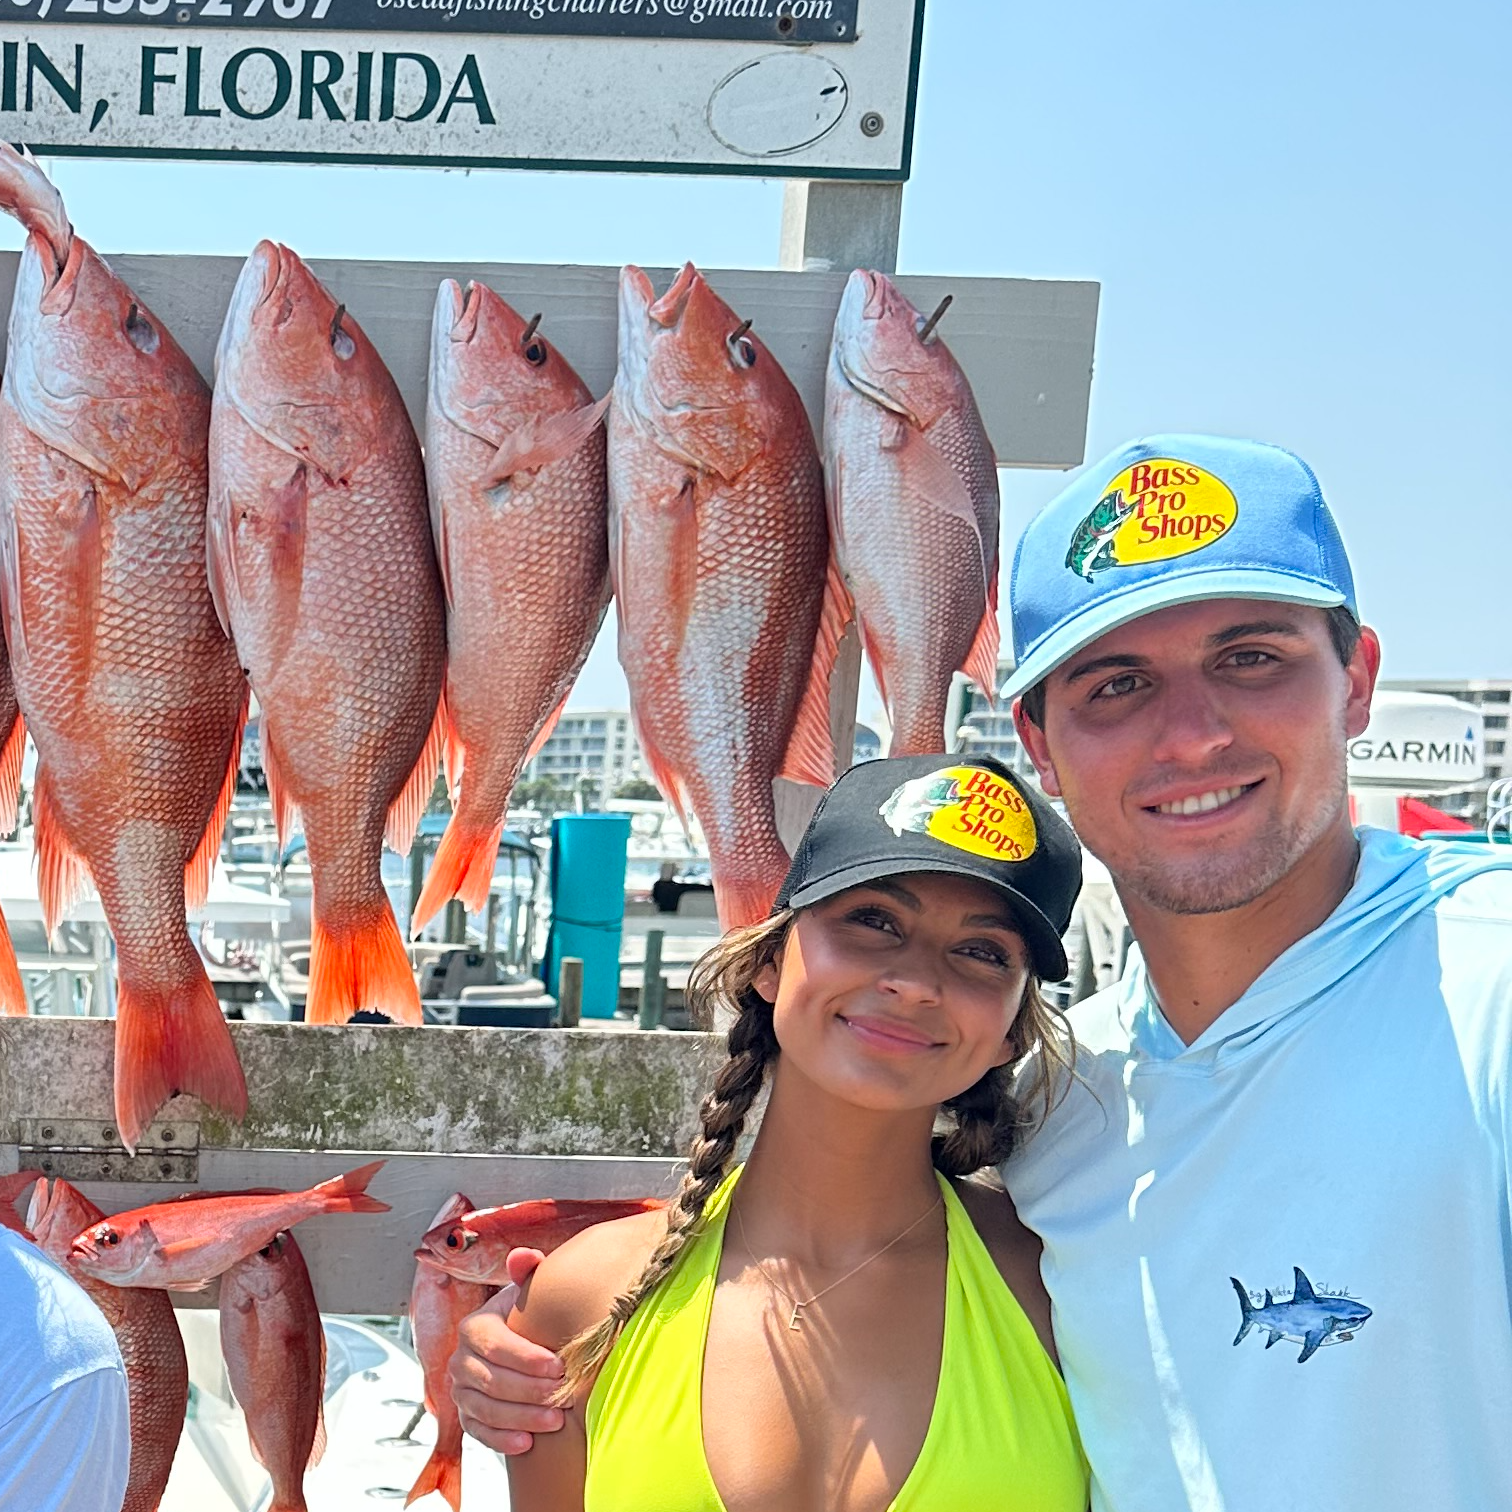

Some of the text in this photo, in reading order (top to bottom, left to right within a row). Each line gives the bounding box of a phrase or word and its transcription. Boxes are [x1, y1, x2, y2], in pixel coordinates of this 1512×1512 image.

[140, 44, 496, 125] FLORIDA
[1129, 464, 1200, 496] Bass
[1135, 491, 1186, 520] Pro
[1138, 514, 1226, 544] Shops
[1350, 740, 1476, 765] GARMIN
[963, 771, 1025, 813] Bass
[958, 794, 1004, 823] Pro
[952, 813, 1025, 860] Shops
